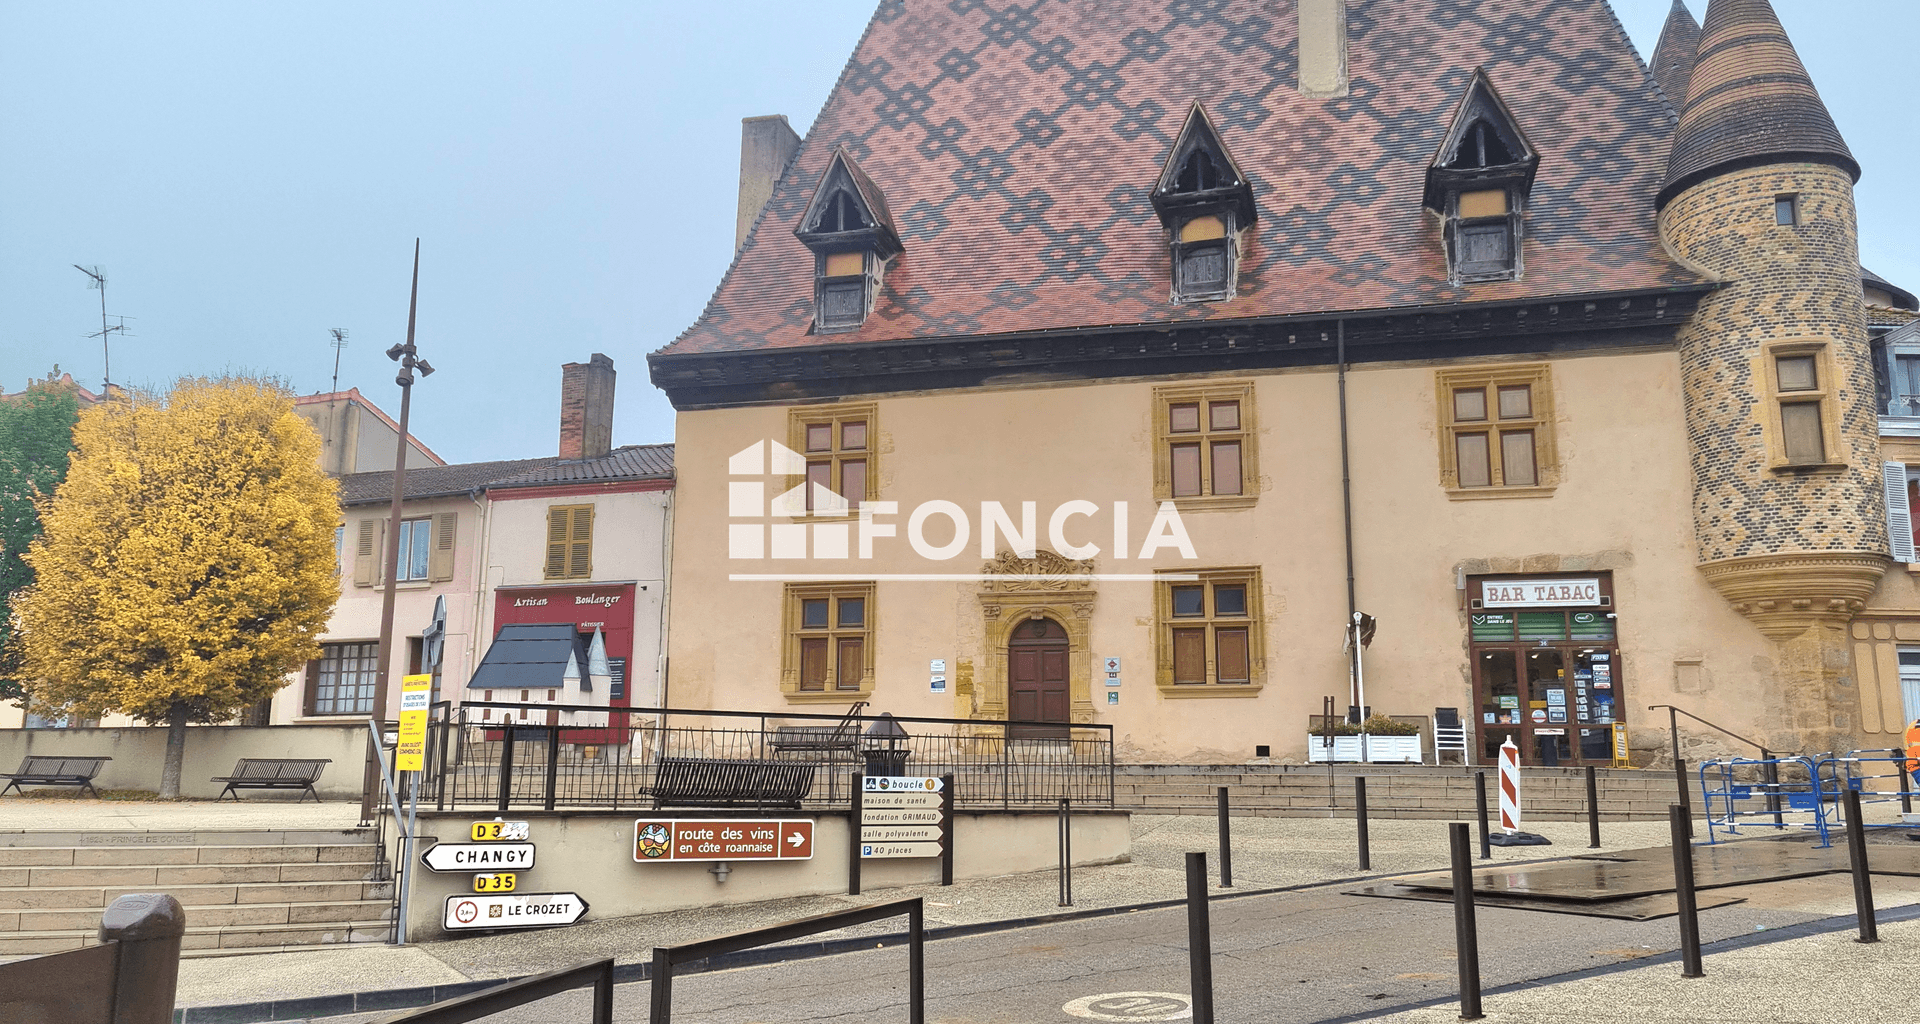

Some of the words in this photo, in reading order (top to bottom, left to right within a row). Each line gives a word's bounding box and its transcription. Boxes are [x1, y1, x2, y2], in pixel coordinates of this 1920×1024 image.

[1487, 587, 1525, 602] BAR
[1534, 585, 1595, 601] TABAC
[513, 597, 549, 607] Artisan
[574, 593, 621, 608] Boulanger
[892, 780, 923, 789] boucle
[863, 813, 899, 821] fondation
[902, 813, 937, 821] GRIMAUD
[477, 825, 486, 838] D
[679, 829, 714, 840] route
[720, 827, 743, 840] des
[750, 828, 775, 840] vins
[863, 830, 882, 838] salle
[885, 830, 929, 839] polyvalente
[679, 844, 693, 853] en
[698, 842, 721, 853] côte
[725, 842, 773, 853] roannaise
[888, 846, 912, 855] places
[455, 850, 527, 863] CHANGY
[477, 876, 486, 889] D
[492, 876, 513, 888] 35
[508, 905, 522, 916] LE
[525, 903, 570, 915] CROZET
